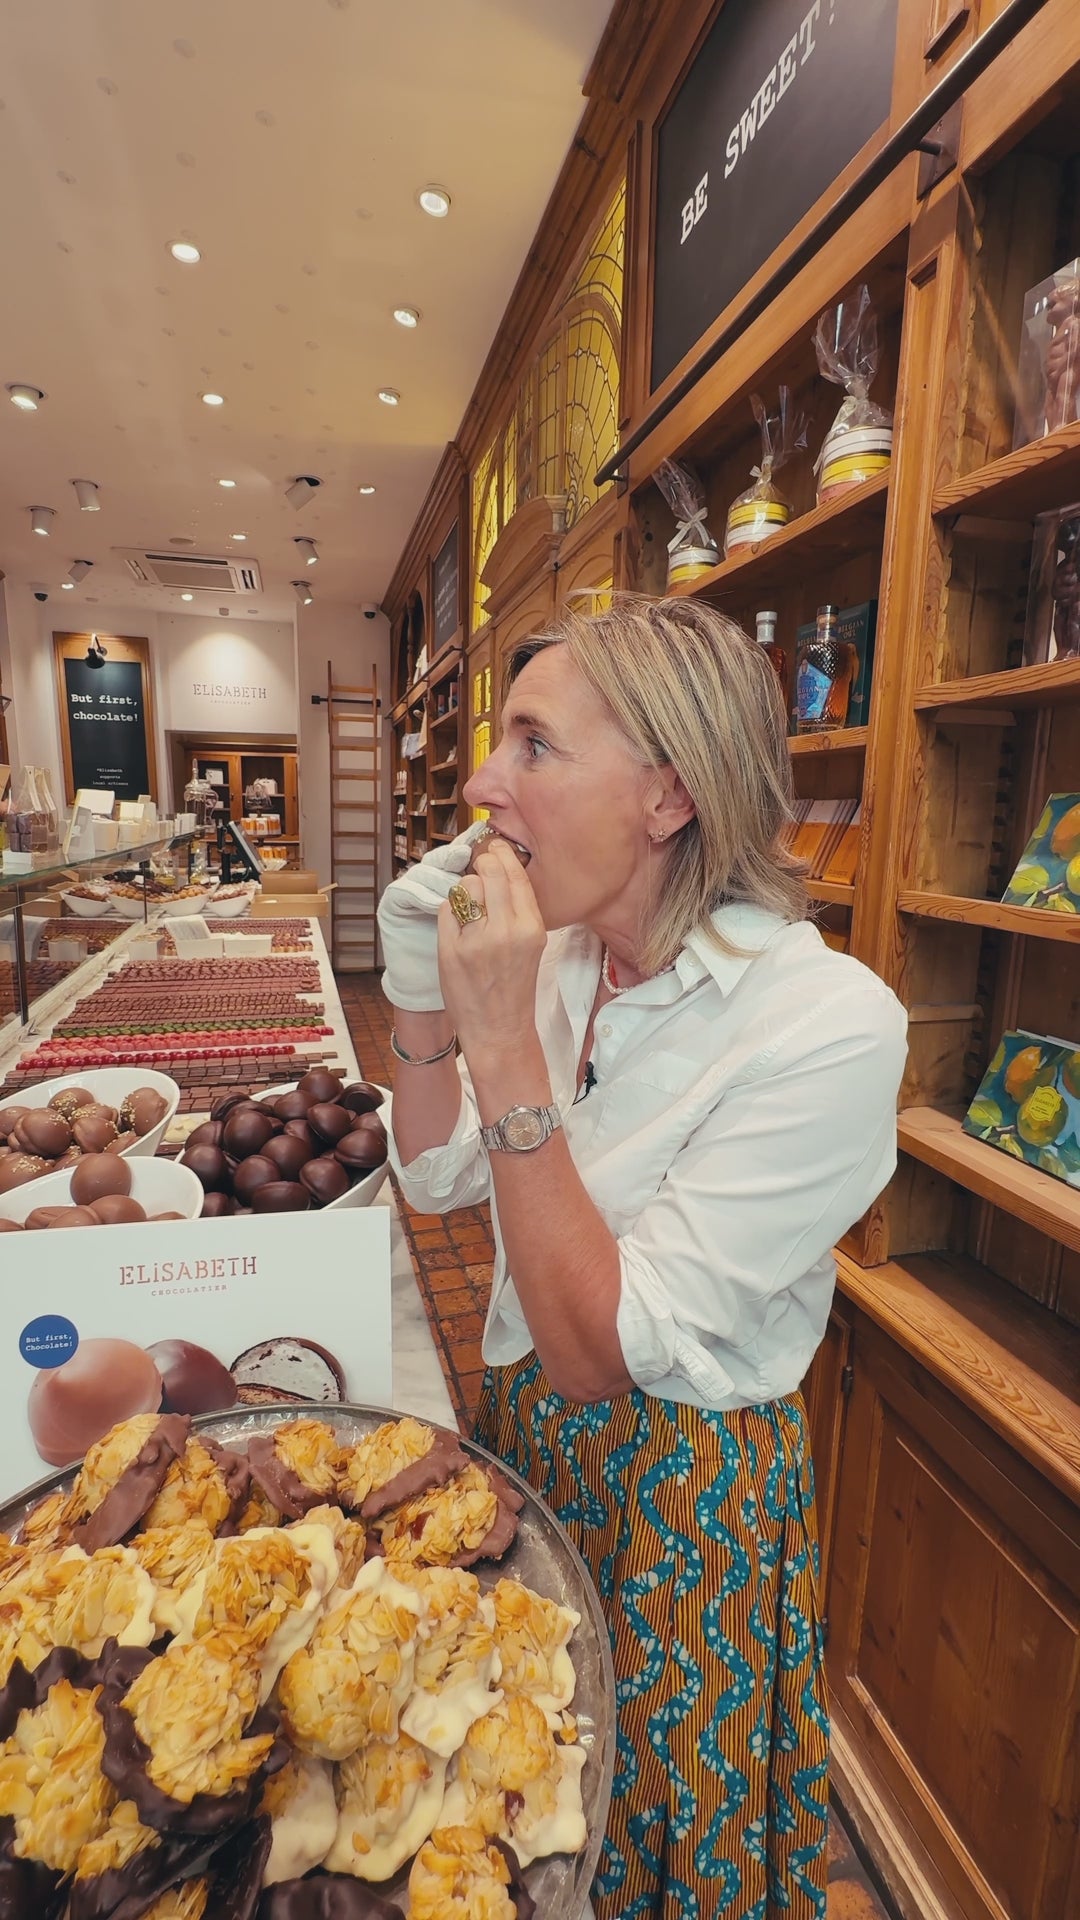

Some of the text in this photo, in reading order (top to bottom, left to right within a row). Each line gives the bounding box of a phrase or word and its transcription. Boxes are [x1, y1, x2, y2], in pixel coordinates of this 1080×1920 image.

[681, 171, 708, 245] BE
[71, 694, 138, 706] But first,
[73, 711, 138, 722] chocolate!
[151, 1284, 228, 1297] CHOCOLATIER
[45, 1333, 72, 1341] first,
[25, 1341, 73, 1351] Chocolate!
